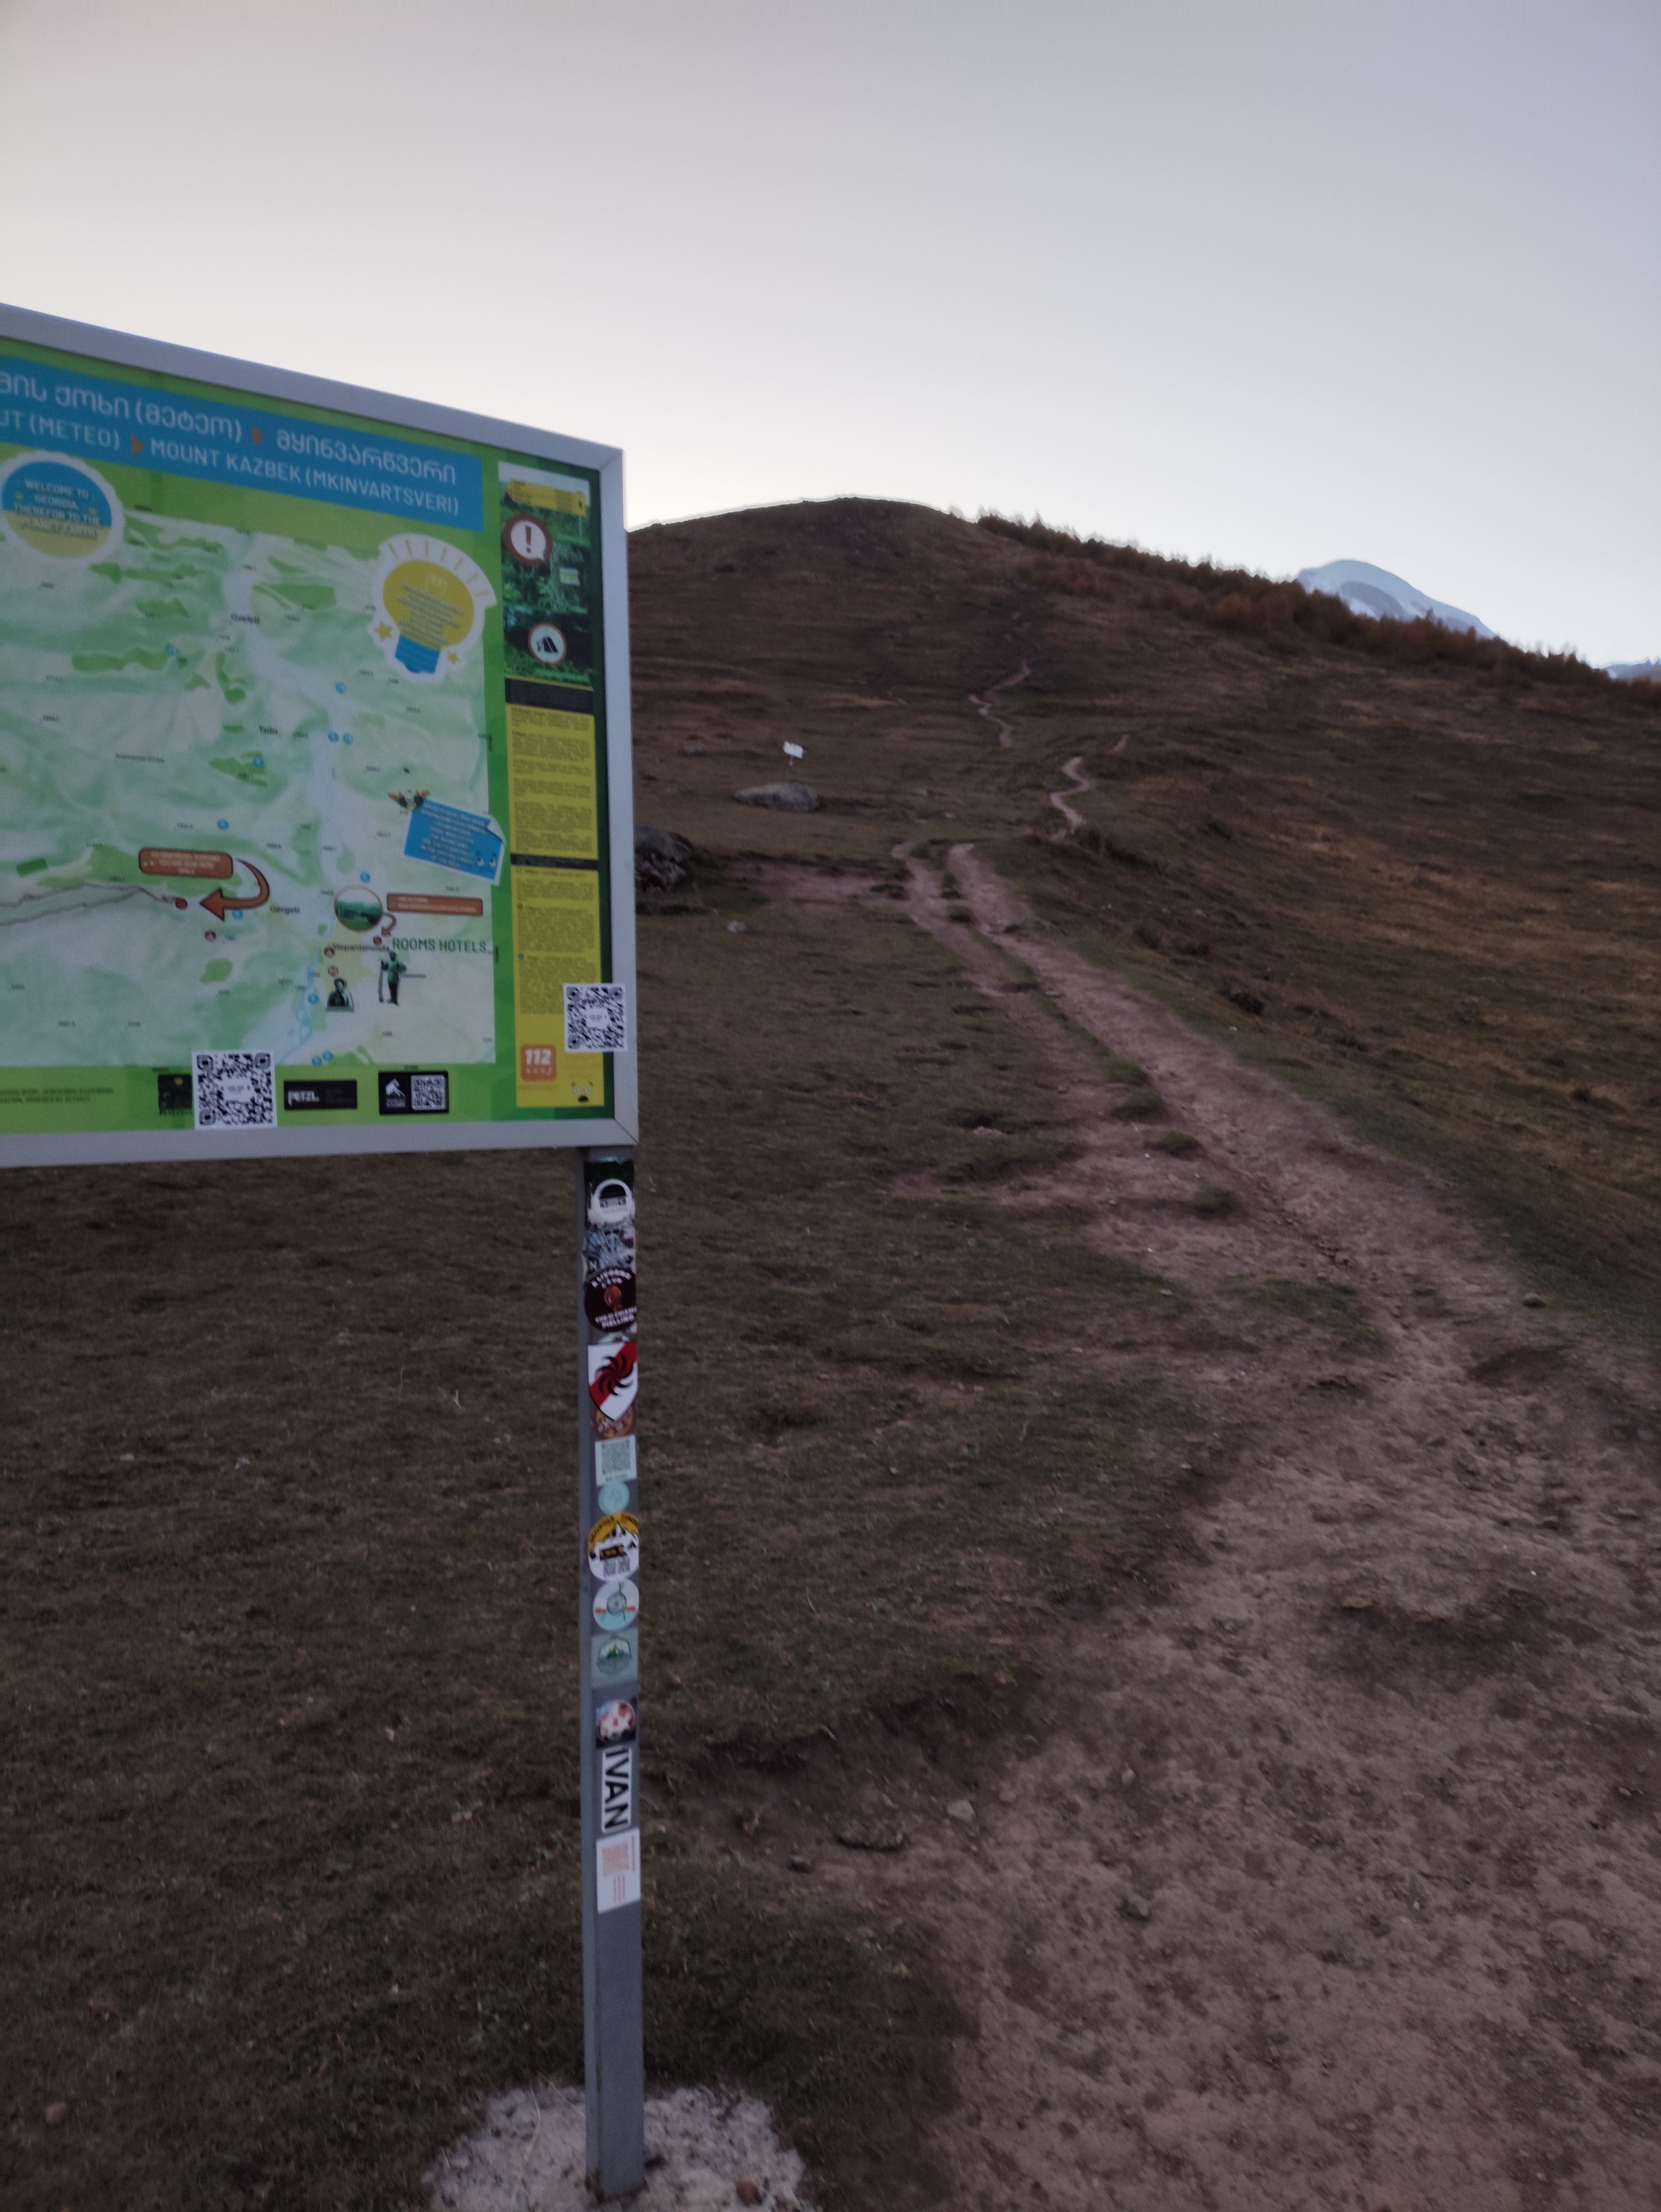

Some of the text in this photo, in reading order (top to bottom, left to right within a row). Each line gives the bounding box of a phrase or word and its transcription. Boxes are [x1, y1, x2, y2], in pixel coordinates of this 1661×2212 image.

[29, 413, 120, 451] (METEO)
[151, 438, 220, 467] MOUNT
[226, 453, 301, 483] KAZBEK
[306, 466, 459, 516] (MKINVARTSVERI)
[25, 479, 89, 499] WELCOME TO
[35, 494, 77, 509] GEORGIA
[392, 938, 487, 953] ROOMS HOTELS
[525, 1048, 552, 1065] 112
[605, 1747, 630, 1828] IVAN
